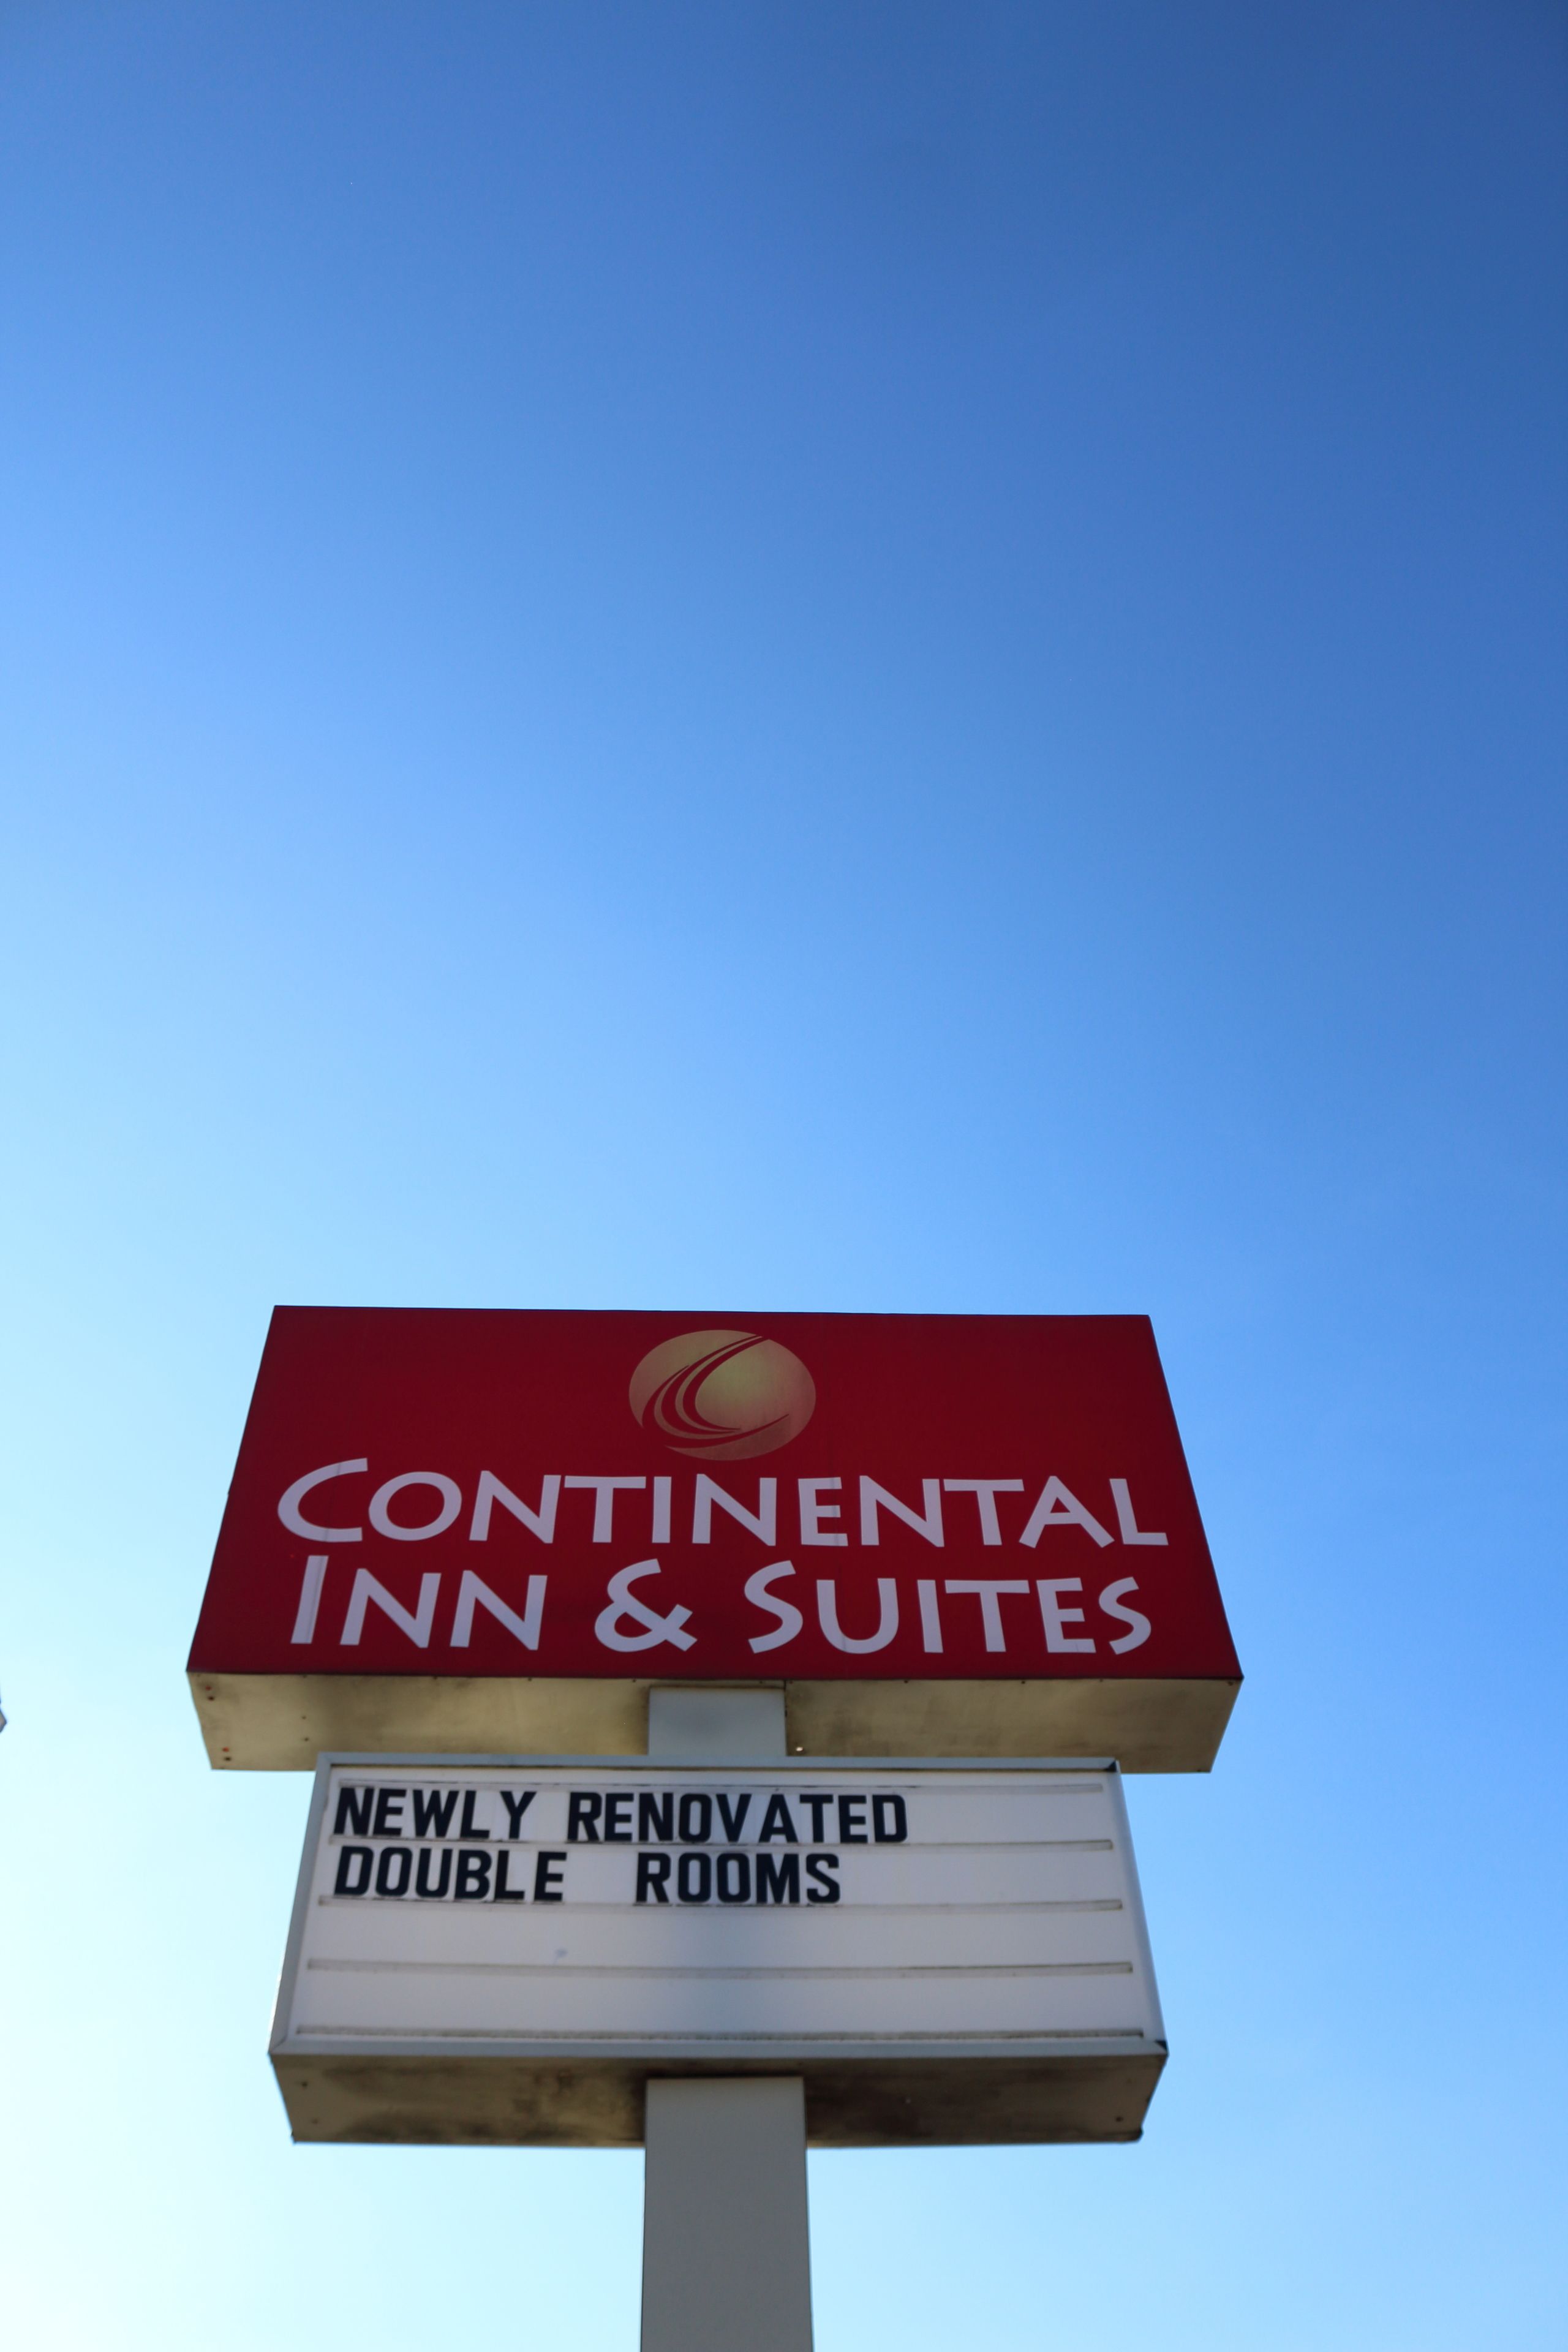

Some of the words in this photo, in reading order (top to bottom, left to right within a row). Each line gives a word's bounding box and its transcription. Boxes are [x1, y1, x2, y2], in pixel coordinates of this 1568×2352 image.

[277, 1458, 1169, 1548] CONTINENTAL
[290, 1555, 548, 1650] INN
[594, 1559, 698, 1653] &
[744, 1560, 1152, 1655] SUITES
[333, 1786, 537, 1840] NEWLY
[567, 1792, 908, 1844] RENOVATED
[334, 1846, 567, 1901] DOUBLE
[636, 1852, 841, 1904] ROOMS
